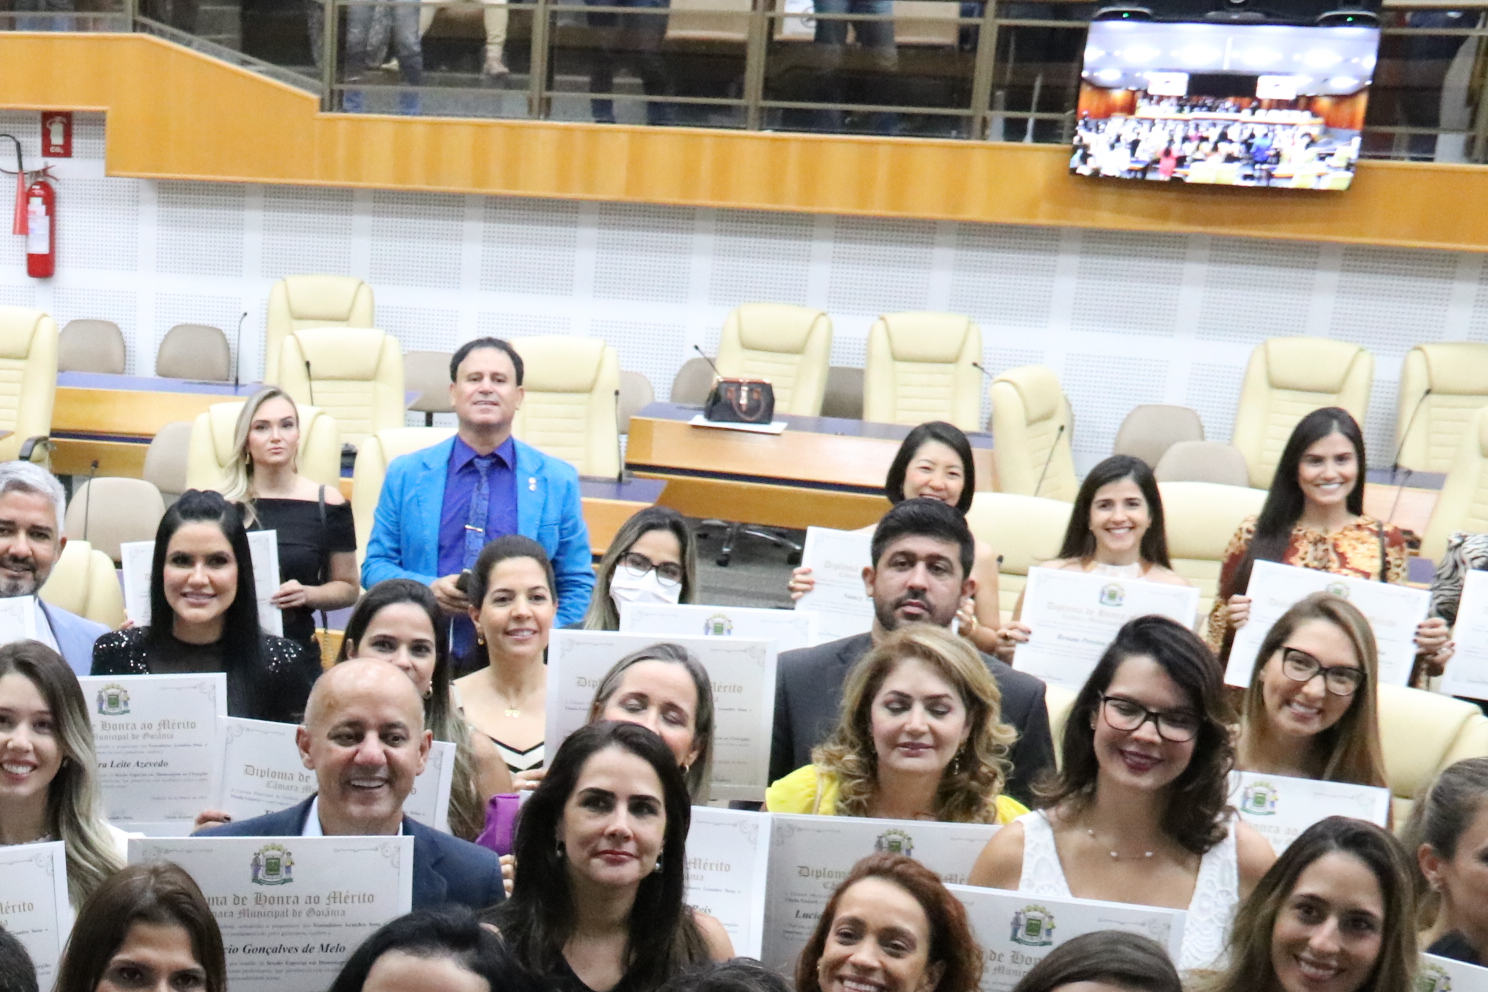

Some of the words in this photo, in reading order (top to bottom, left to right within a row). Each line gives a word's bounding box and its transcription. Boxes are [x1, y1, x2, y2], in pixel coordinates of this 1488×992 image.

[100, 720, 135, 732] Honra
[140, 722, 153, 731] ao
[157, 719, 196, 731] Mérito
[111, 760, 131, 769] Leite
[133, 760, 169, 768] Azevedo
[244, 764, 294, 782] Diploma
[299, 770, 311, 783] de
[685, 857, 731, 872] Mérito
[233, 893, 248, 906] de
[254, 892, 299, 906] Honra
[305, 894, 320, 905] ao
[325, 891, 375, 906] Mérito
[242, 944, 299, 956] Gonçalves
[302, 944, 315, 954] de
[320, 944, 346, 953] Melo
